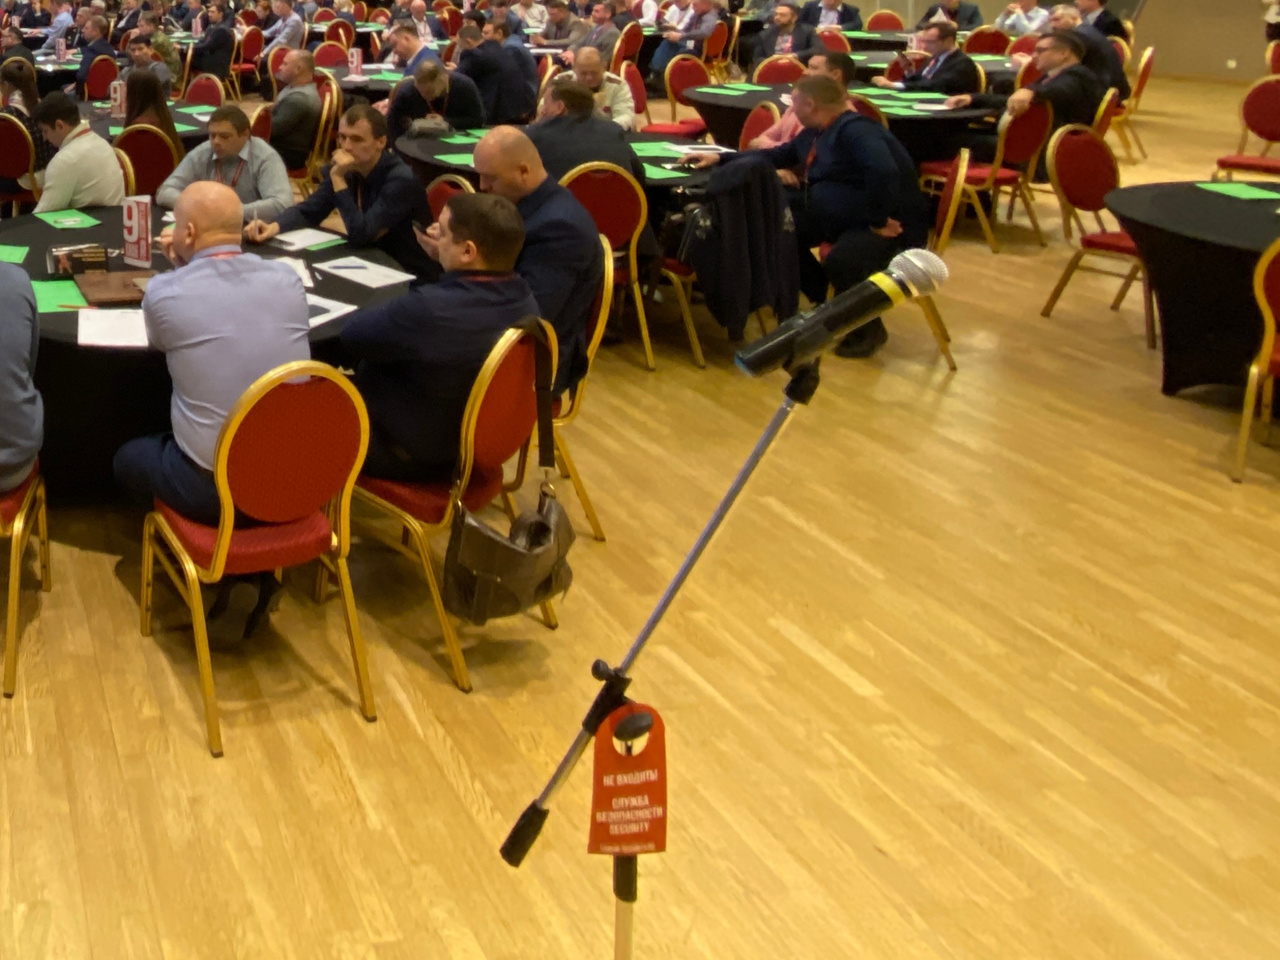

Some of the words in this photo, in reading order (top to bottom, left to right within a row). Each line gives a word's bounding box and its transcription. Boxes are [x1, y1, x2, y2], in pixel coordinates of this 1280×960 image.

[348, 48, 358, 68] 9
[110, 81, 121, 106] 9
[122, 199, 139, 243] 9
[603, 774, 615, 787] НЕ
[612, 794, 650, 810] СЛУЖБА
[596, 806, 663, 823] БЕЗОПАСНОСТИ
[609, 821, 650, 836] SECURITY
